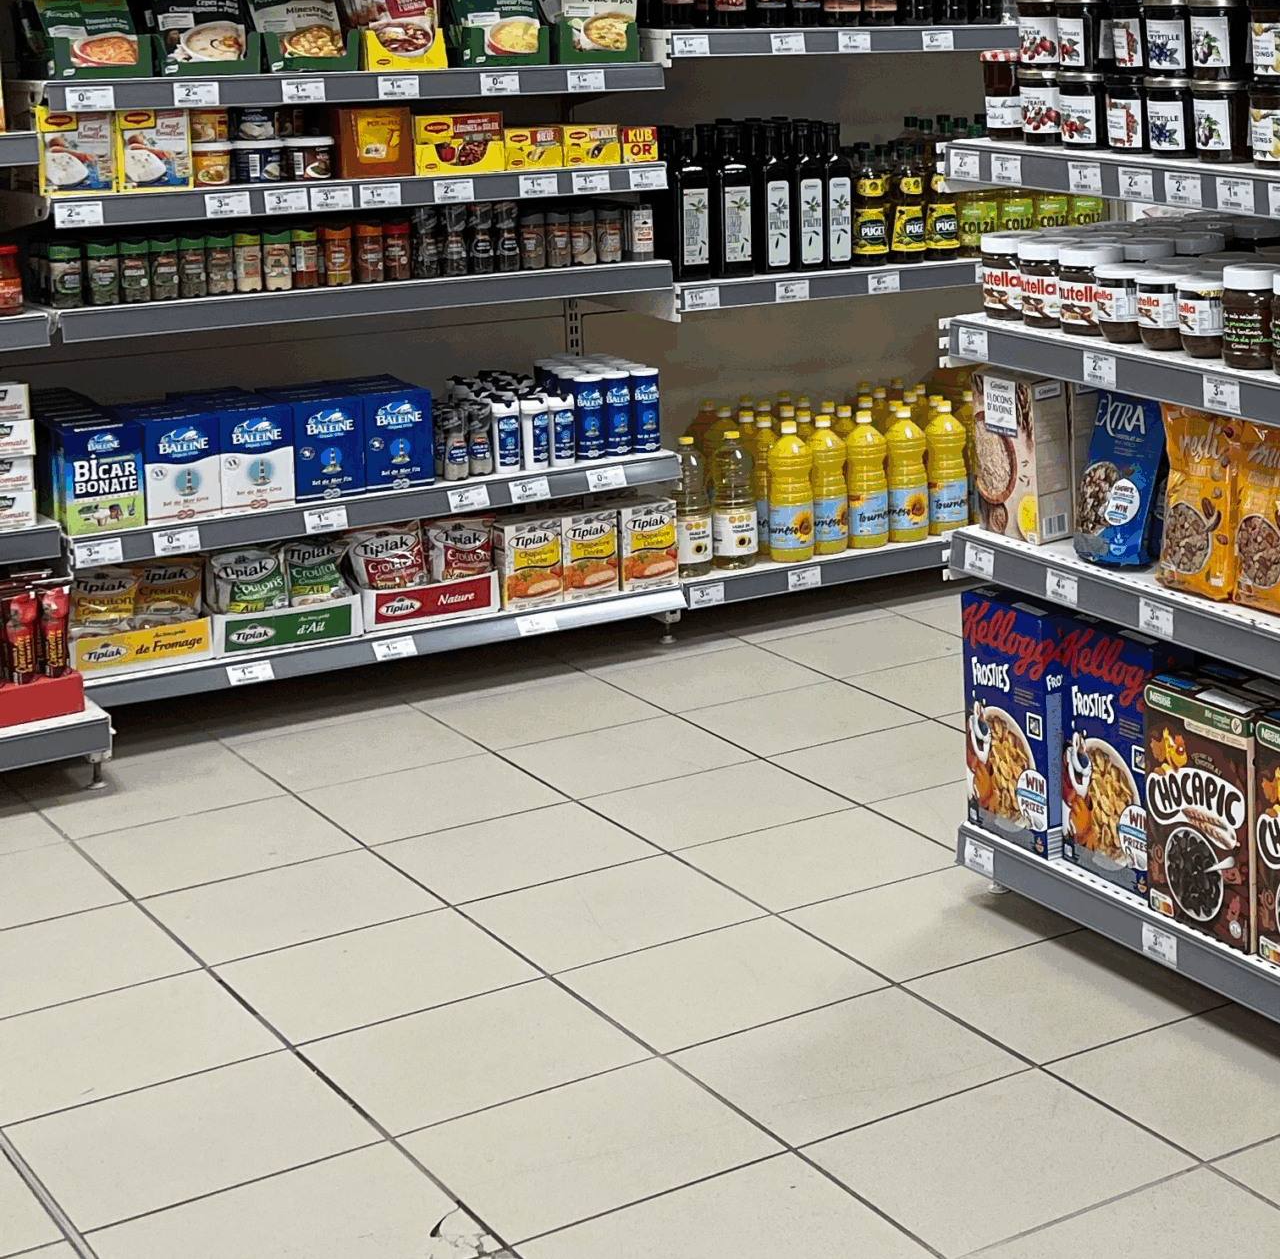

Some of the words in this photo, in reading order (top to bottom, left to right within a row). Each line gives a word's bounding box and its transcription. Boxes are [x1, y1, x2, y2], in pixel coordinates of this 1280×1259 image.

[286, 5, 333, 17] Minestrone
[628, 129, 651, 141] KUB
[630, 144, 651, 155] OR
[986, 392, 1016, 406] FLOCONS
[987, 404, 1014, 419] D'AVOINE
[1096, 401, 1145, 434] EXTRA
[306, 420, 354, 436] BALEINE
[74, 477, 138, 494] BONATE
[515, 533, 548, 547] Tipiak
[514, 550, 554, 560] Chapelure
[438, 592, 474, 605] Nature
[234, 628, 270, 641] Tipiak
[297, 622, 325, 635] d'Ail
[135, 644, 150, 654] de
[152, 637, 202, 653] Fromage
[1072, 685, 1113, 725] FROSTIES
[1026, 773, 1044, 788] WIN
[1148, 777, 1243, 821] CHOCAPIC
[1021, 798, 1045, 815] PRIZES
